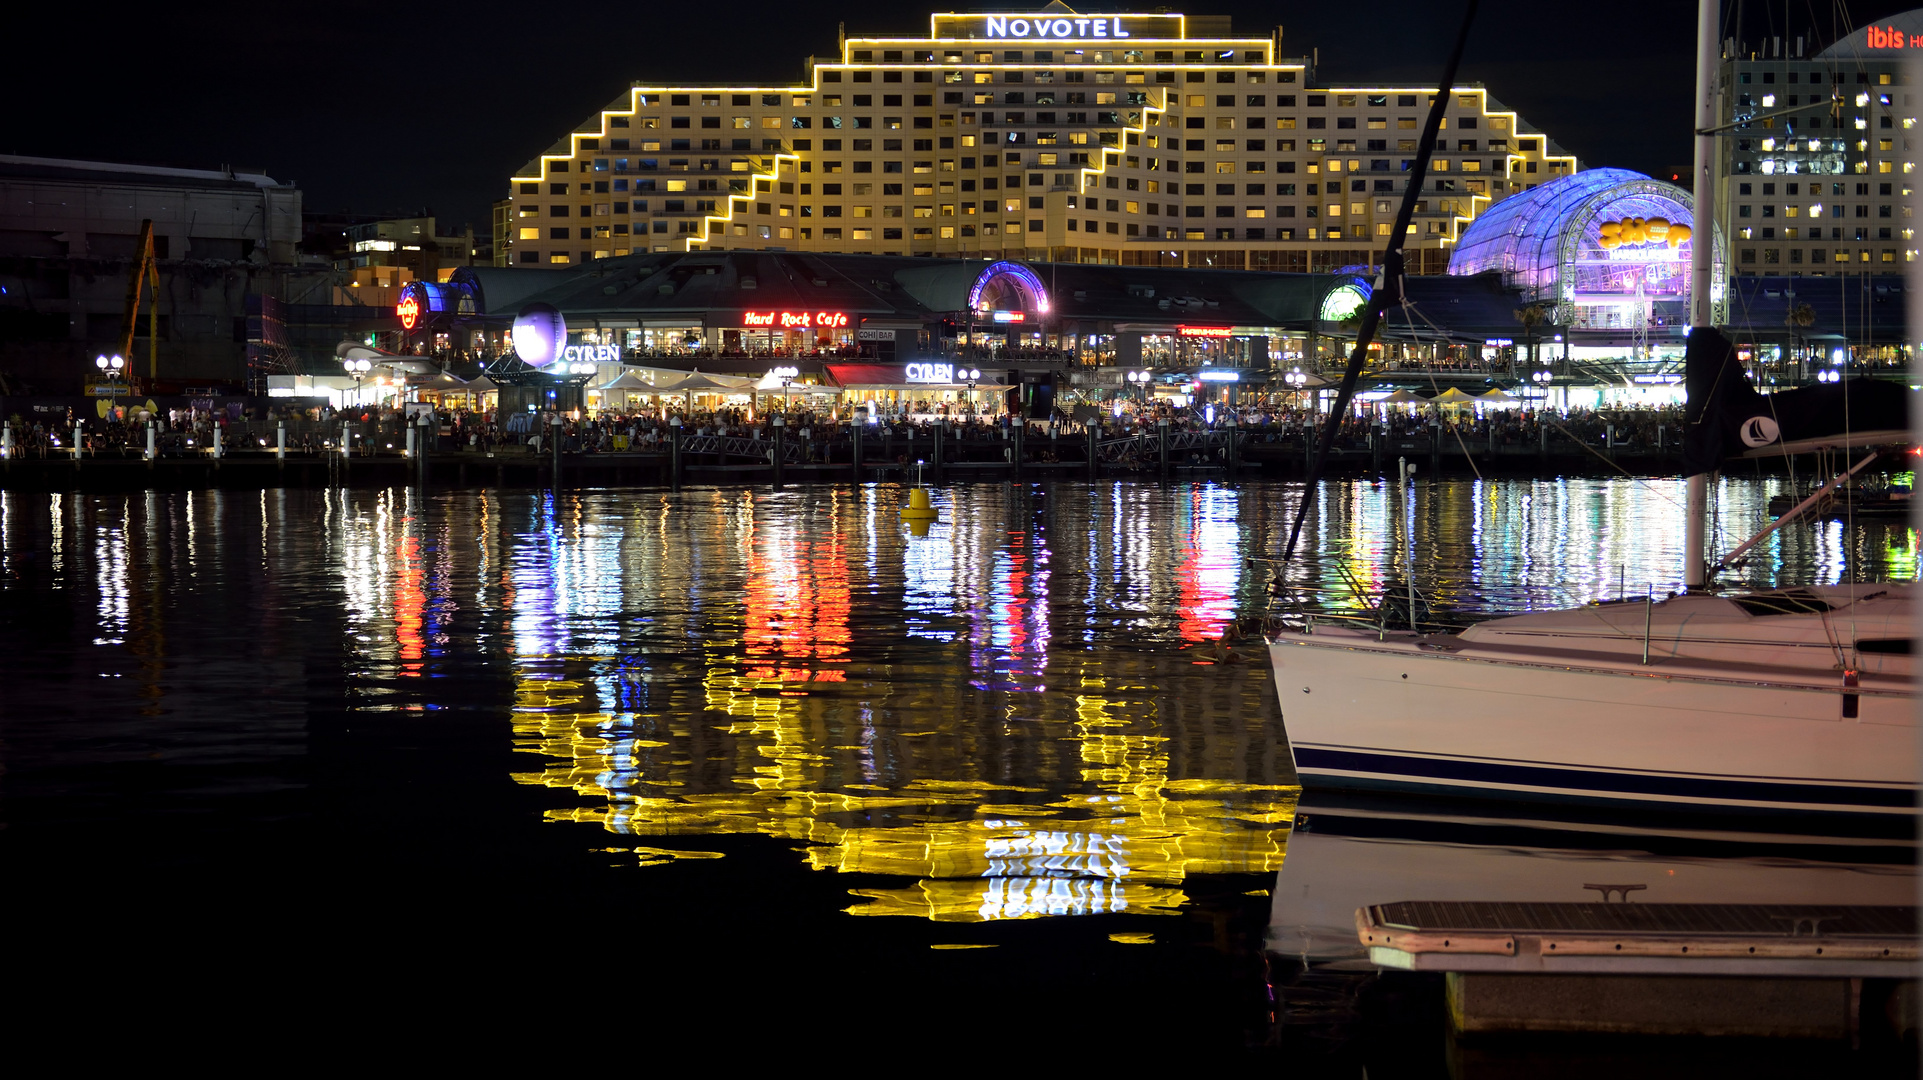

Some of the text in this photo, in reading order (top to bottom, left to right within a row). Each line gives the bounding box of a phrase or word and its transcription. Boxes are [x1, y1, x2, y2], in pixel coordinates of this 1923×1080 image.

[987, 16, 1129, 37] NOVOTEL
[1867, 25, 1904, 49] ibis
[744, 312, 848, 327] Hard Rock Cafe
[859, 331, 893, 340] COHI BAR
[564, 345, 621, 361] CYREN
[905, 363, 954, 379] CYREN
